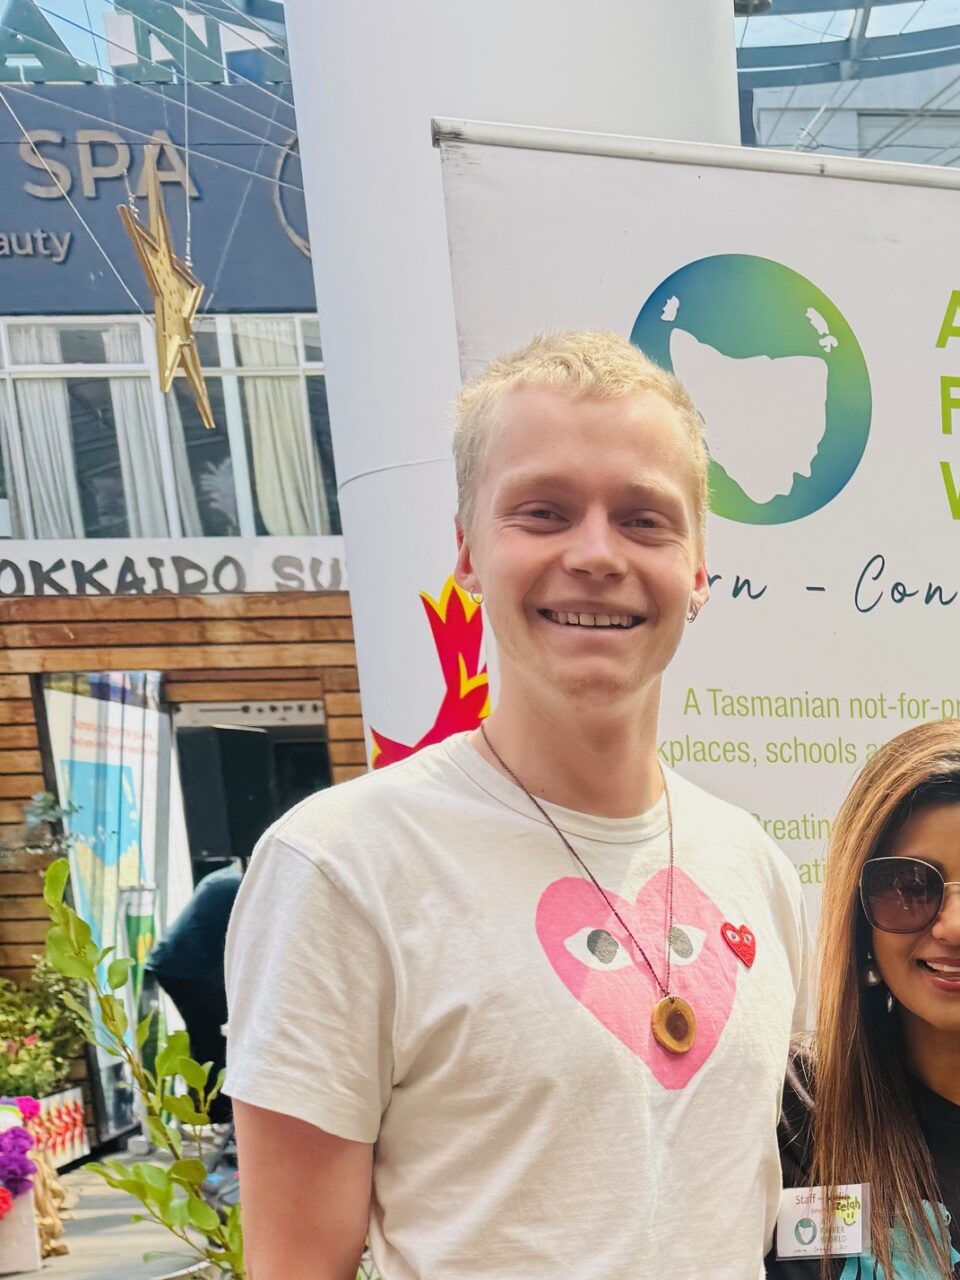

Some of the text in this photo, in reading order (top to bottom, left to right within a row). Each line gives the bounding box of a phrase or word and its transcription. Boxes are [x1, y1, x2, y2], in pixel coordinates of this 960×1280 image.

[18, 128, 201, 200] SPA
[683, 688, 702, 716] A
[706, 688, 841, 719] Tasmanian
[766, 736, 857, 764] schools
